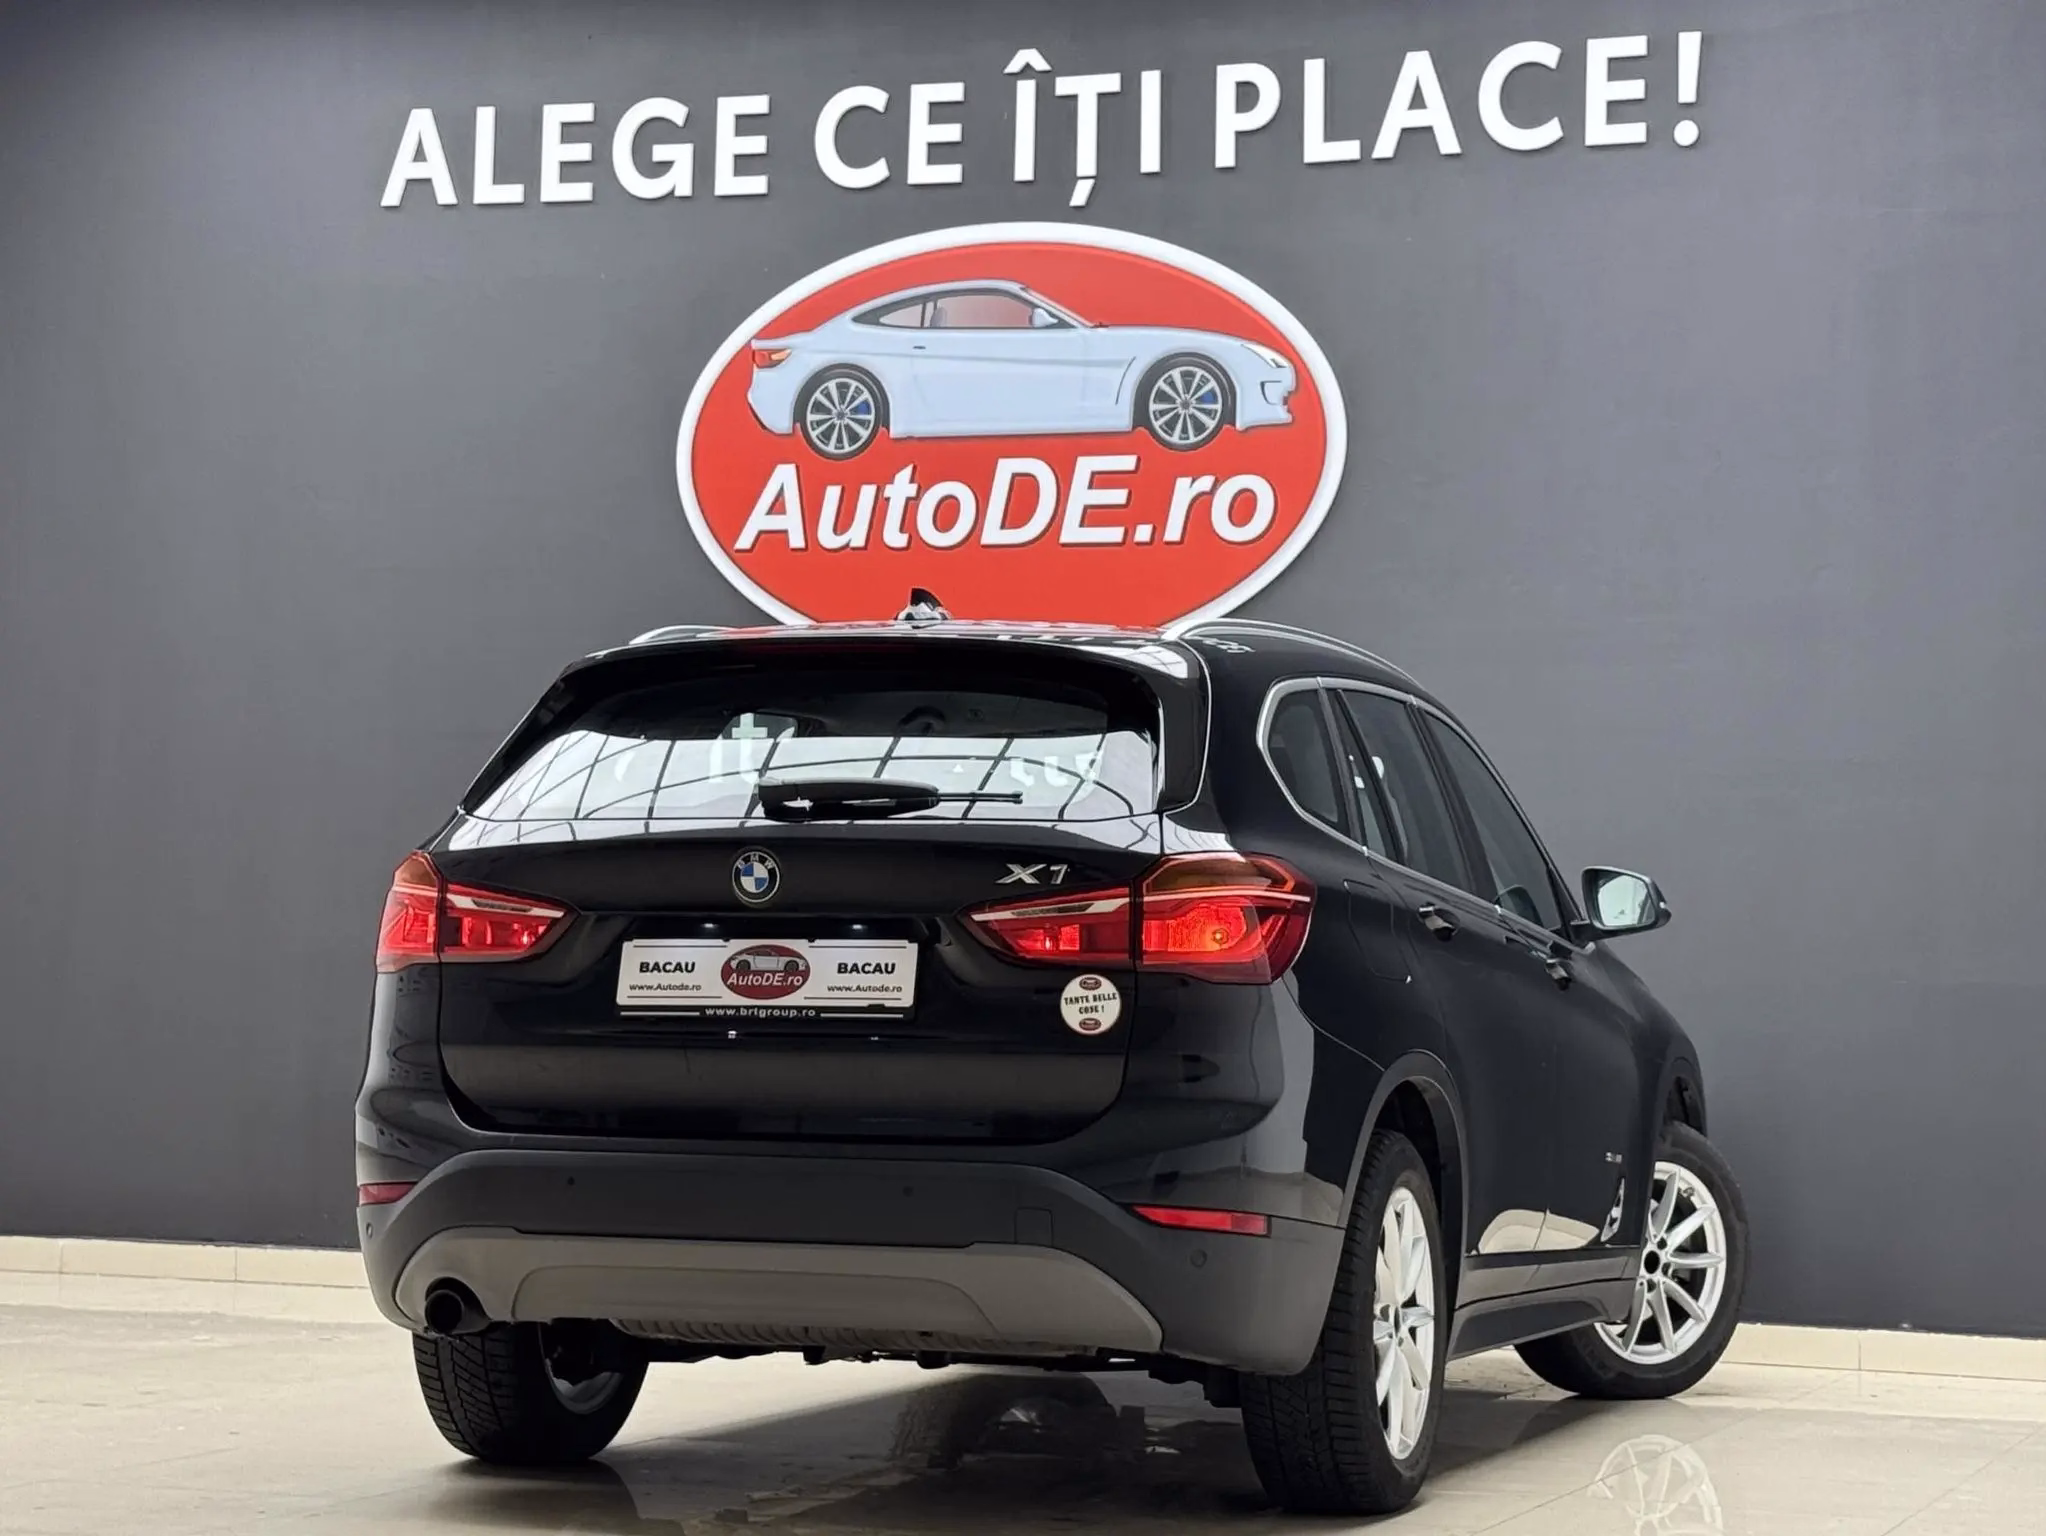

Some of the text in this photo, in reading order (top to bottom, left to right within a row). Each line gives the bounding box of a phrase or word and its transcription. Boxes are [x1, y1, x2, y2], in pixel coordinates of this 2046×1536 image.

[380, 31, 1702, 207] ALEGE CE ÎȚI PLACE!
[733, 454, 1278, 551] AutoDE.ro
[995, 863, 1070, 885] X1
[639, 961, 696, 974] BACAU
[836, 961, 896, 975] BACAU
[726, 972, 803, 986] AutoDE.ro
[629, 982, 702, 992] www.Autode.ro
[827, 983, 903, 993] www.Autode.ro
